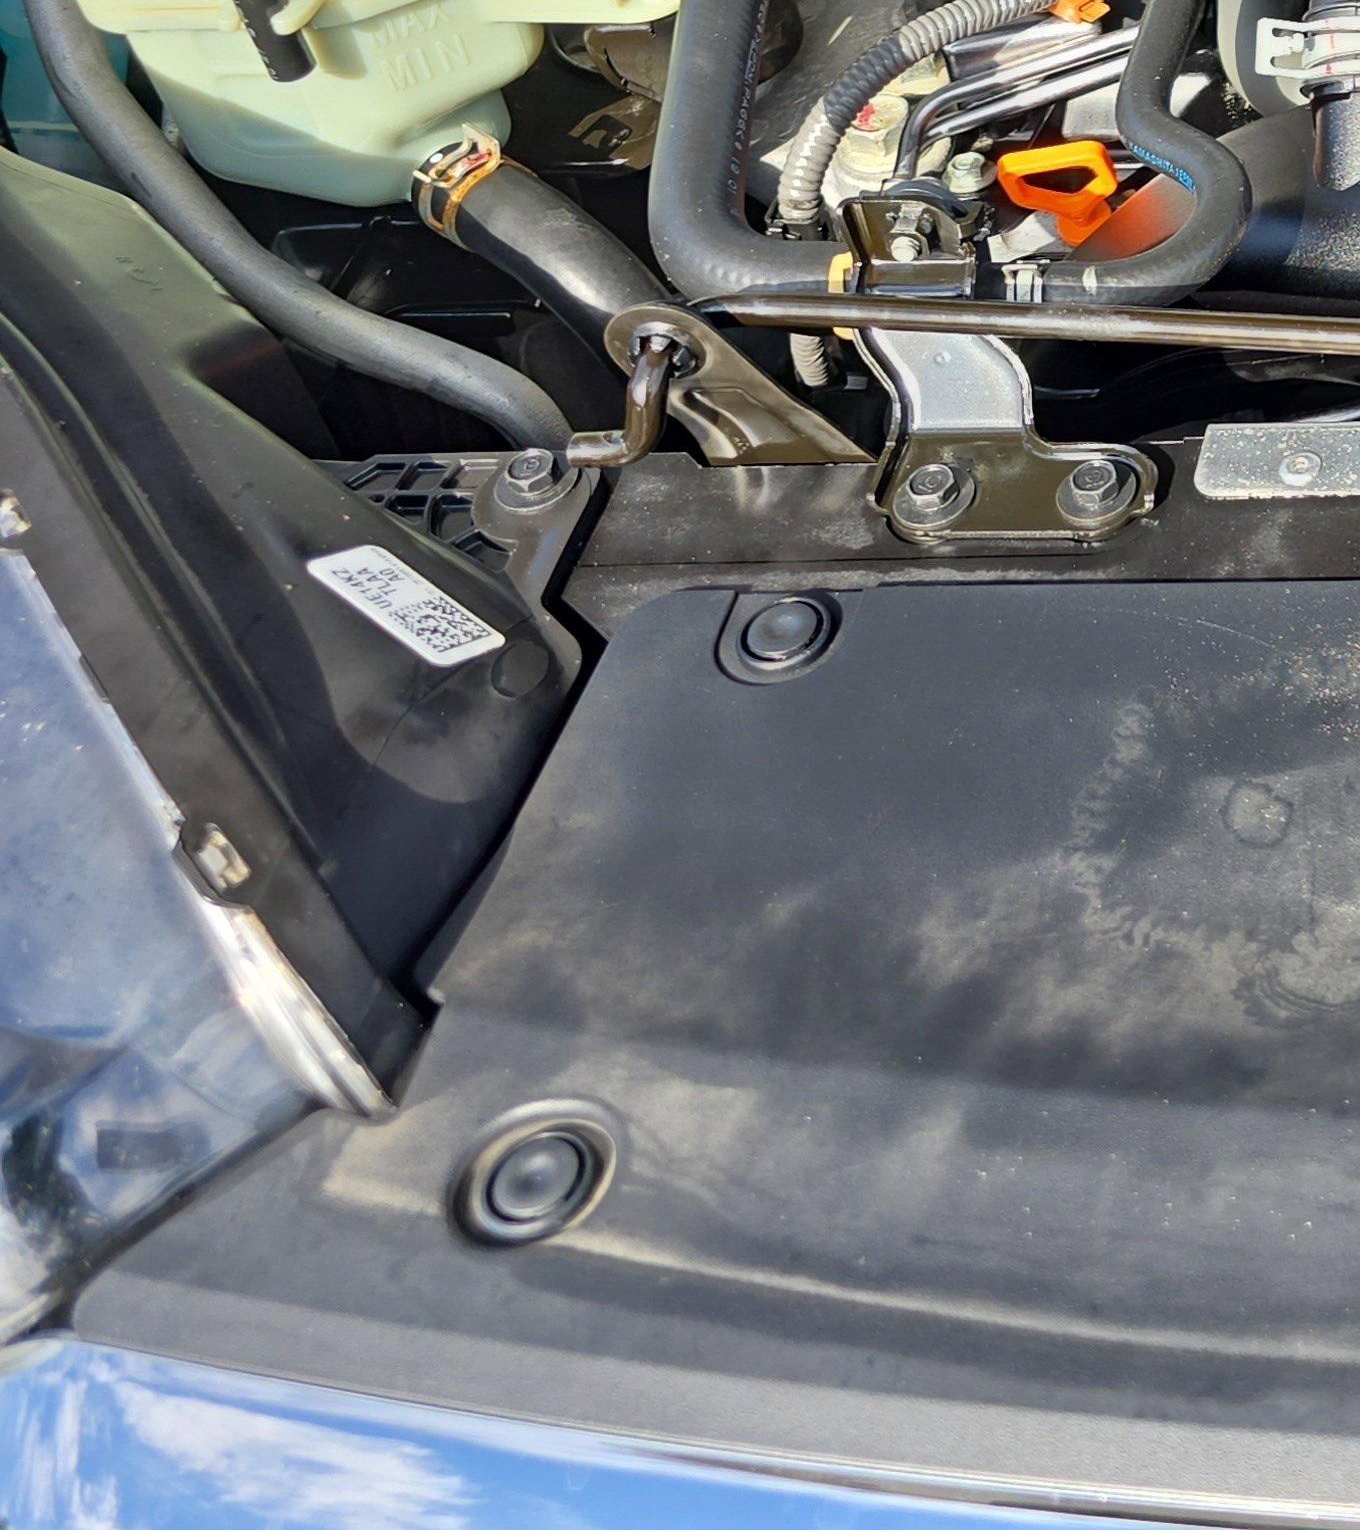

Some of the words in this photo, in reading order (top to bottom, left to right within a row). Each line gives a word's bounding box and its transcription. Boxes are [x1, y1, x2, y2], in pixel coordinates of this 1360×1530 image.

[379, 31, 470, 92] MIN
[331, 566, 393, 609] UE14KZ
[356, 567, 398, 595] TLAA
